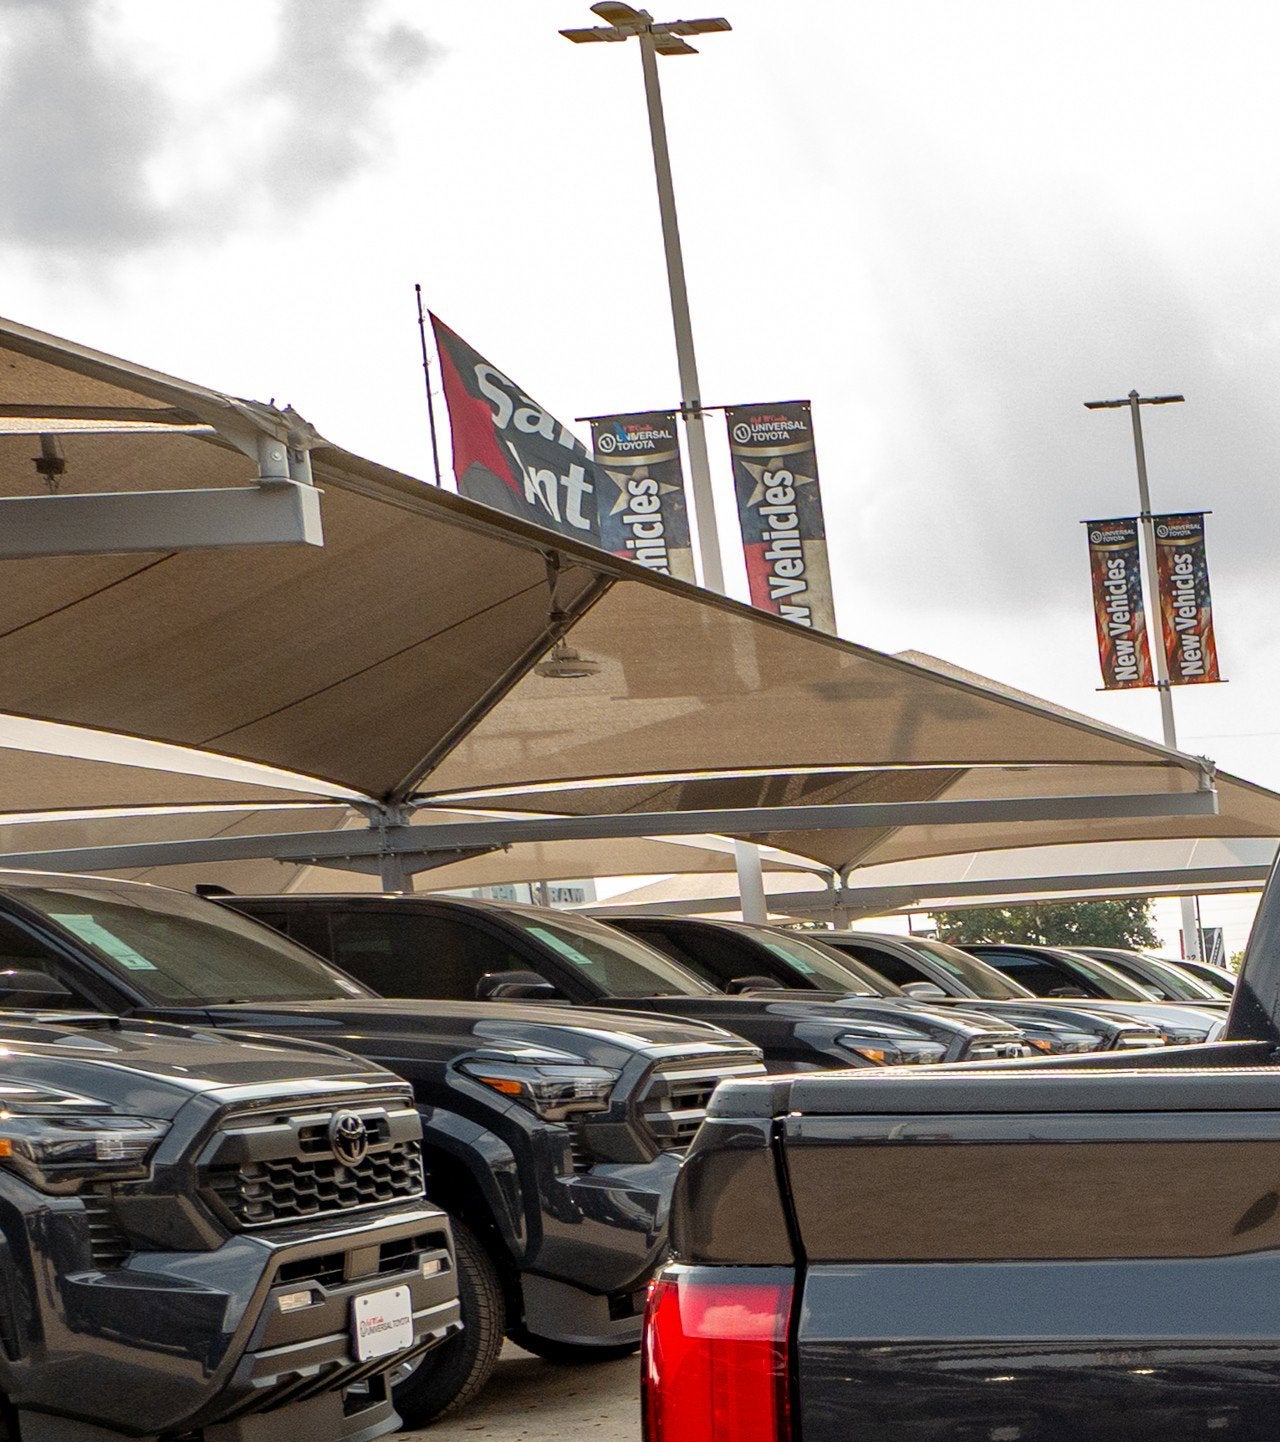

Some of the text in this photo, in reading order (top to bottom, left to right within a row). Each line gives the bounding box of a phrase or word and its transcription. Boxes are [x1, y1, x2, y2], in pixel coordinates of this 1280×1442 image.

[616, 440, 655, 451] TOYOTA
[751, 420, 807, 432] UNIVERSAL
[752, 431, 790, 441] TOYOTA
[623, 478, 670, 576] hicles
[1104, 557, 1132, 637] Vehicles
[1170, 553, 1198, 632] Vehicles
[1115, 639, 1138, 681] New
[1181, 634, 1204, 676] New
